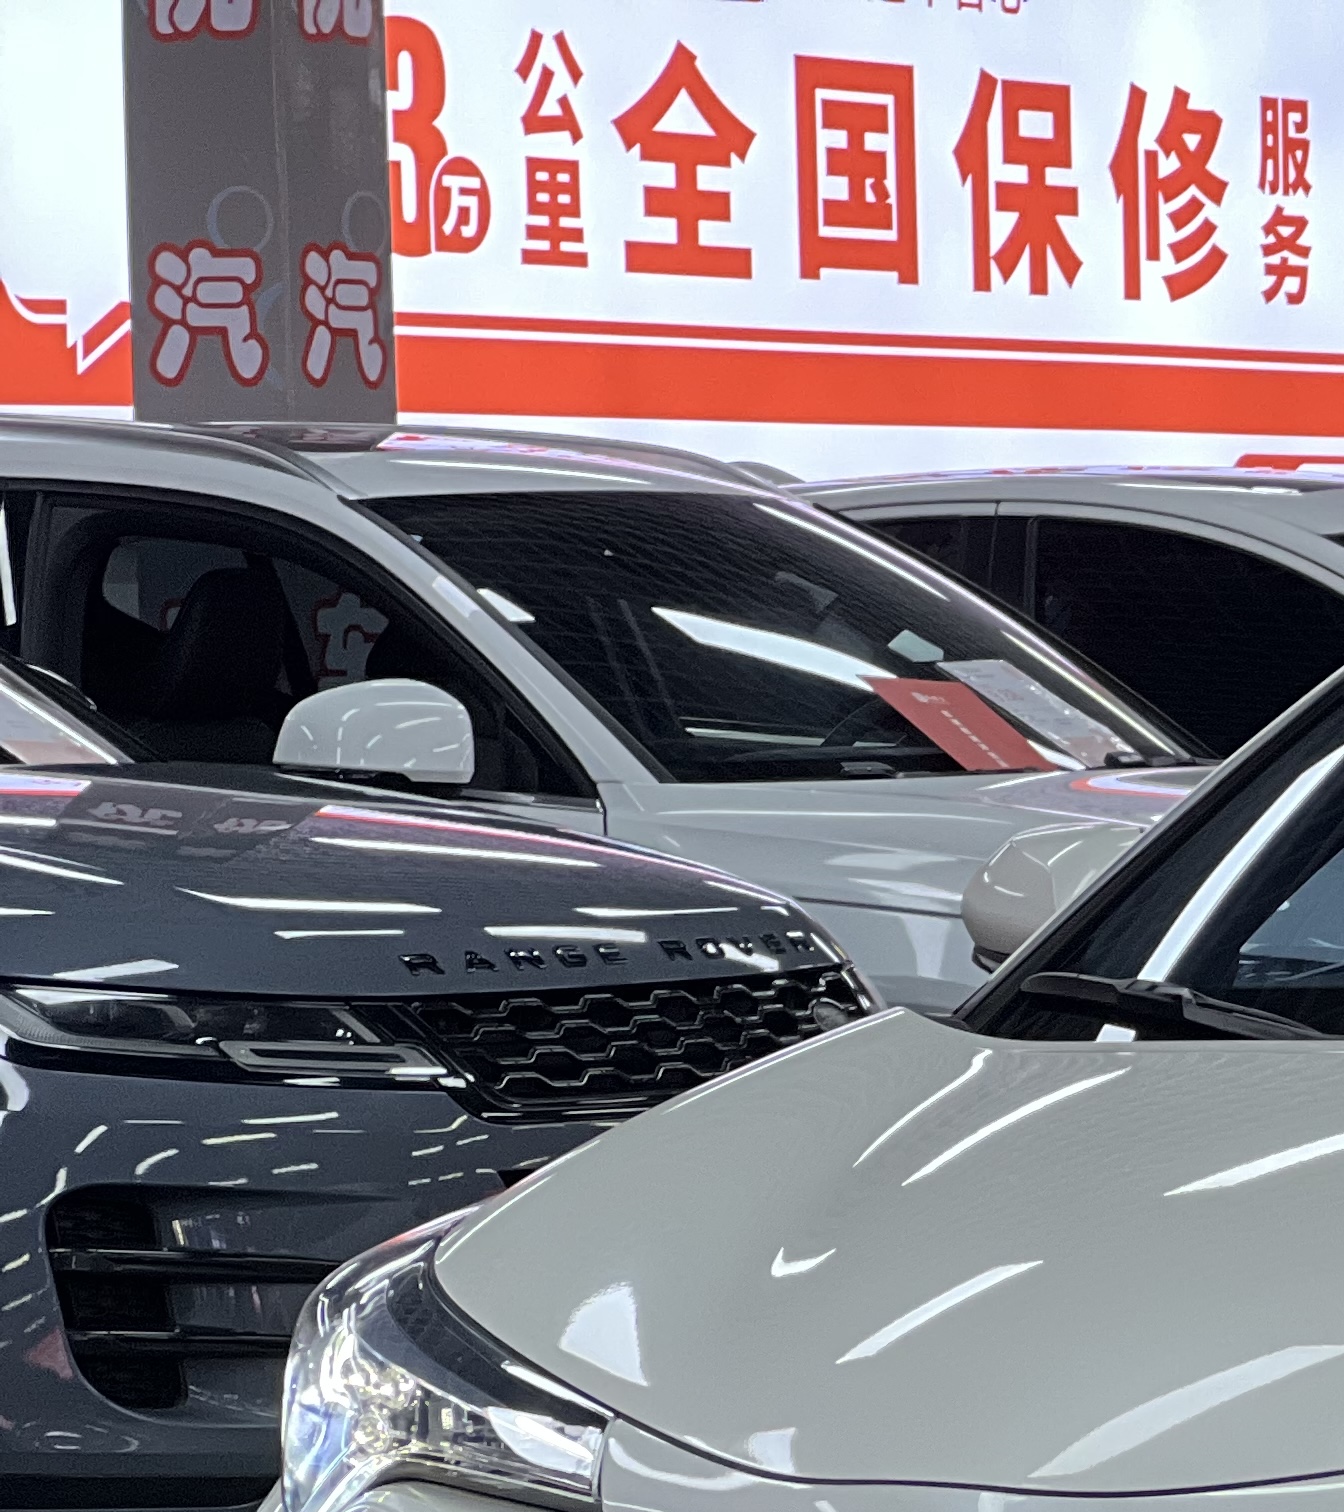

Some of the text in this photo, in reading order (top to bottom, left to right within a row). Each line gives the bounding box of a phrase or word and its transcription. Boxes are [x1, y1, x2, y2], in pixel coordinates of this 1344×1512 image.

[612, 40, 1228, 302] 全国保修
[398, 932, 816, 976] RANGE ROVER
